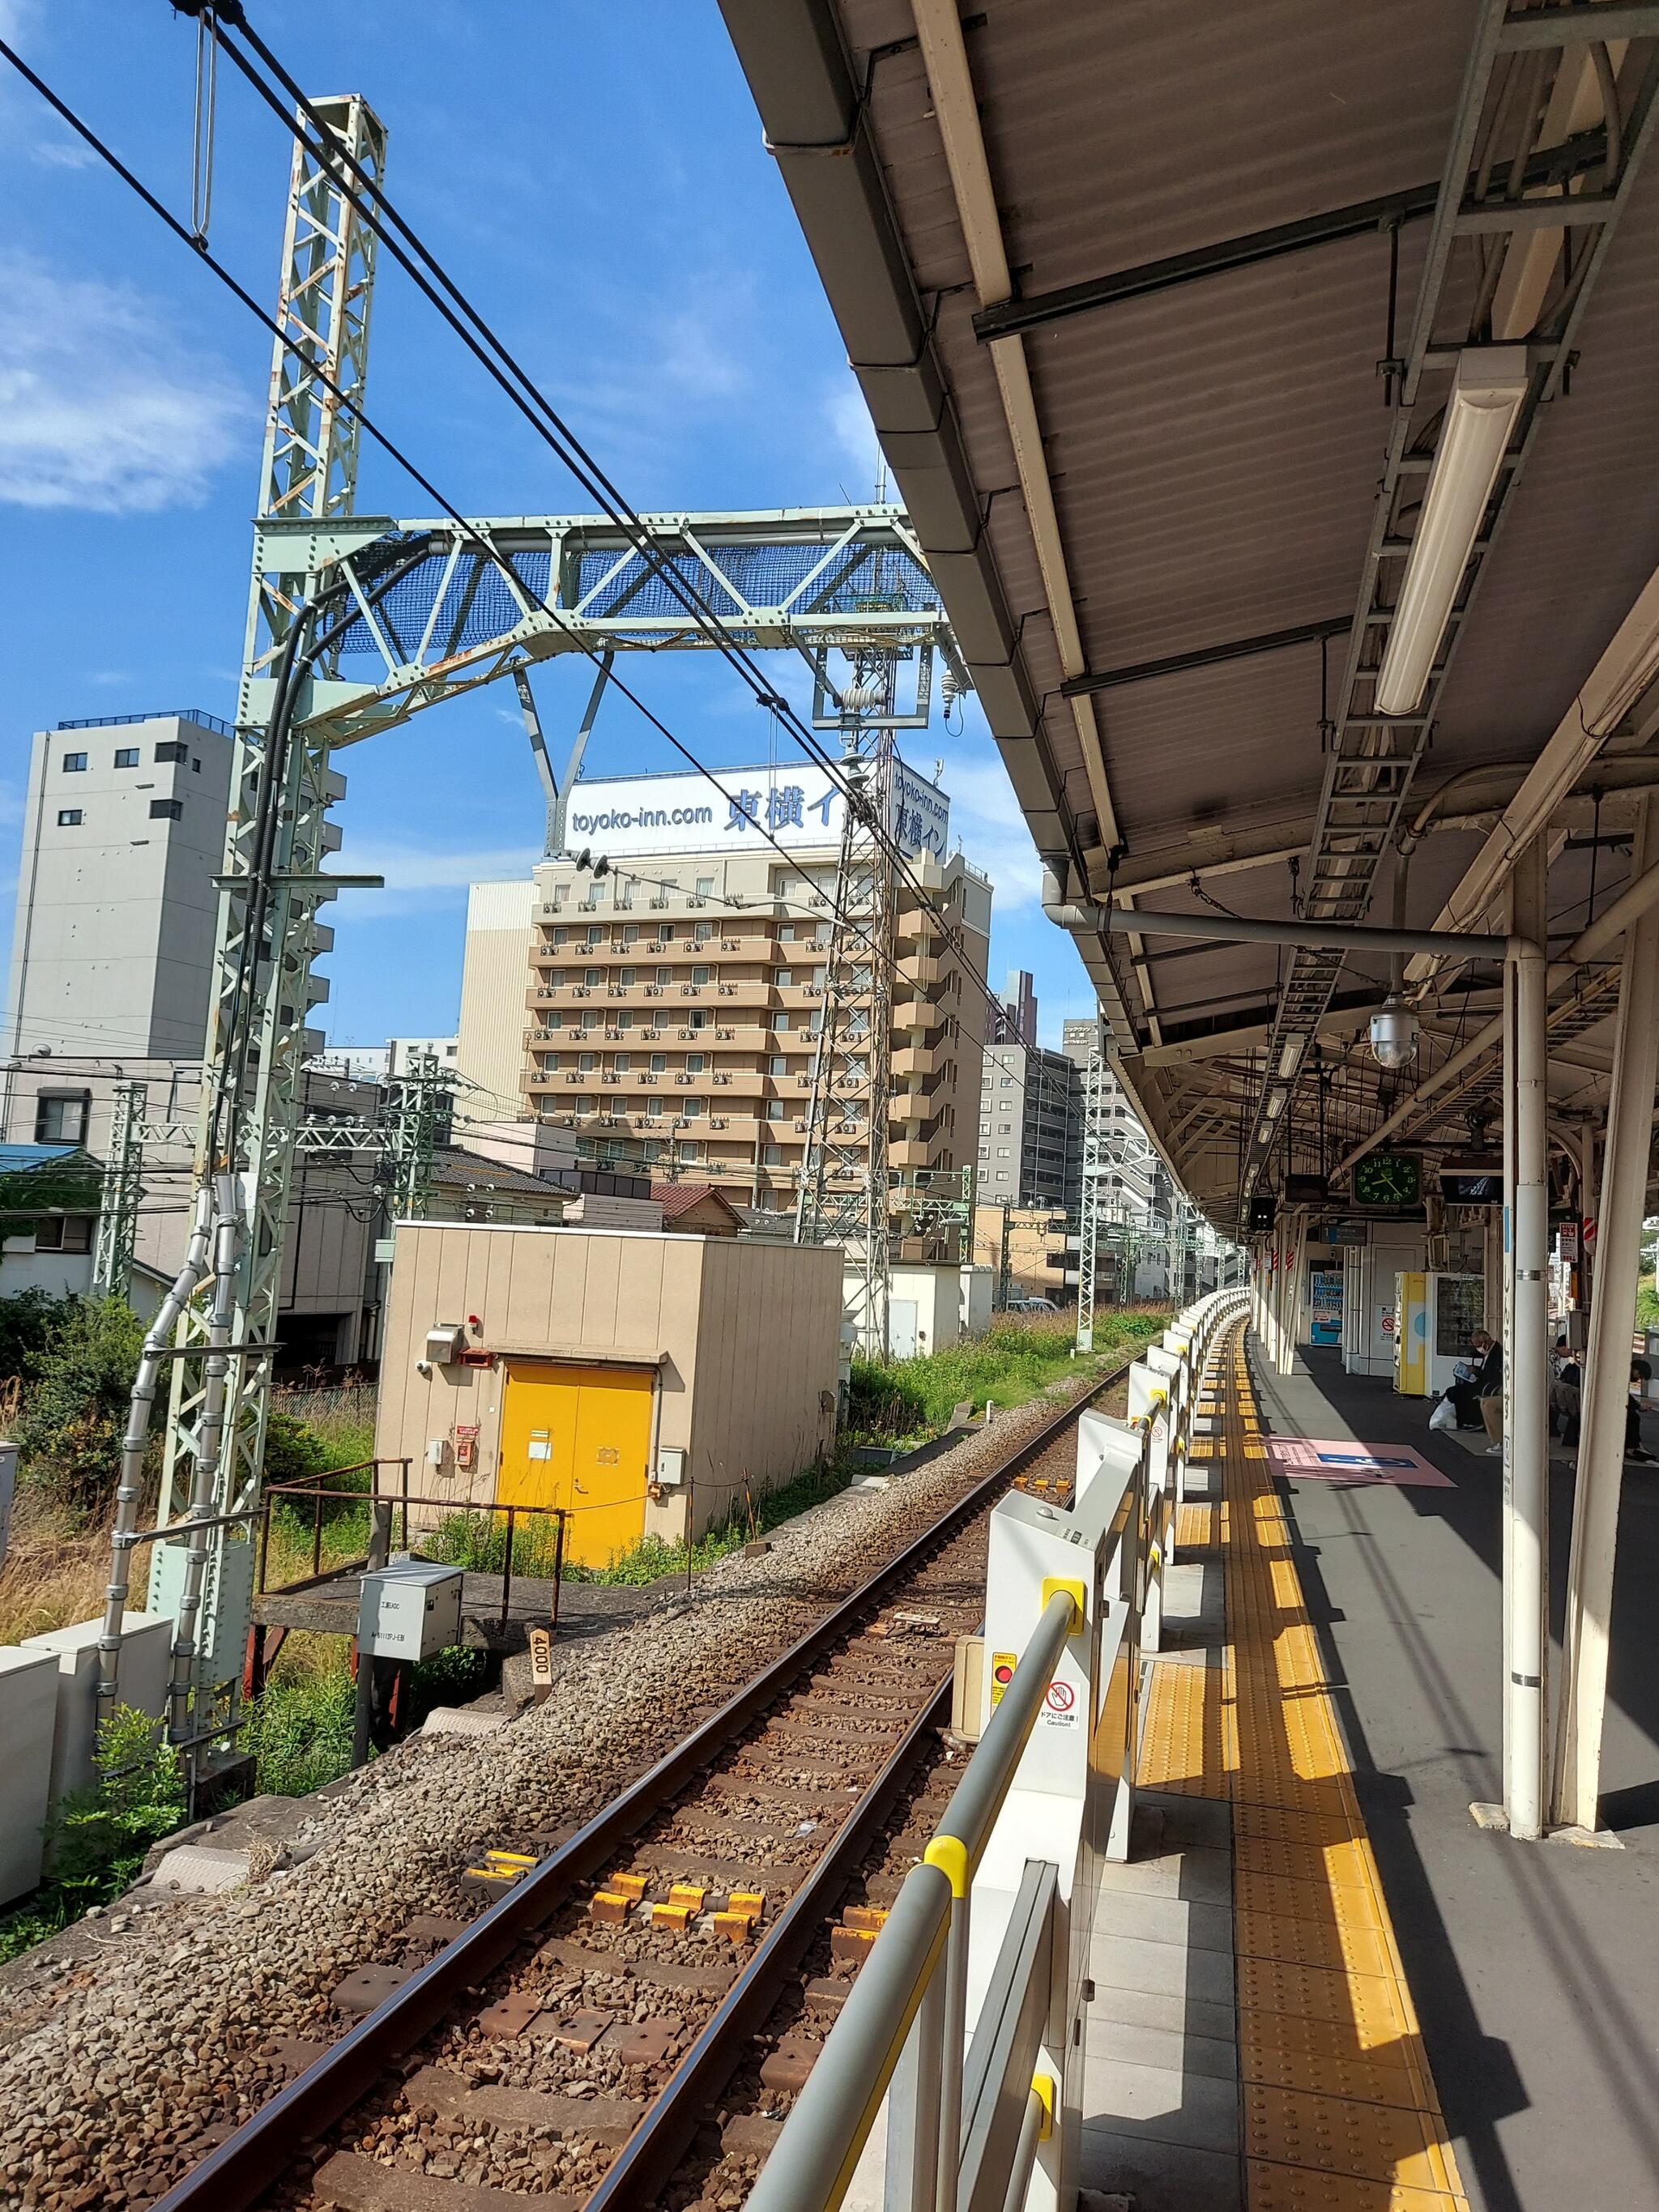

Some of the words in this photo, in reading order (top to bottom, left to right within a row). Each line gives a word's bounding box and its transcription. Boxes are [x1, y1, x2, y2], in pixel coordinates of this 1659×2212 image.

[894, 770, 949, 824] toyoko-inn.com
[572, 806, 713, 835] toyoko-inn.com
[1382, 1157, 1392, 1165] 12
[1324, 1227, 1329, 1238] 1
[533, 1636, 548, 1673] 4000
